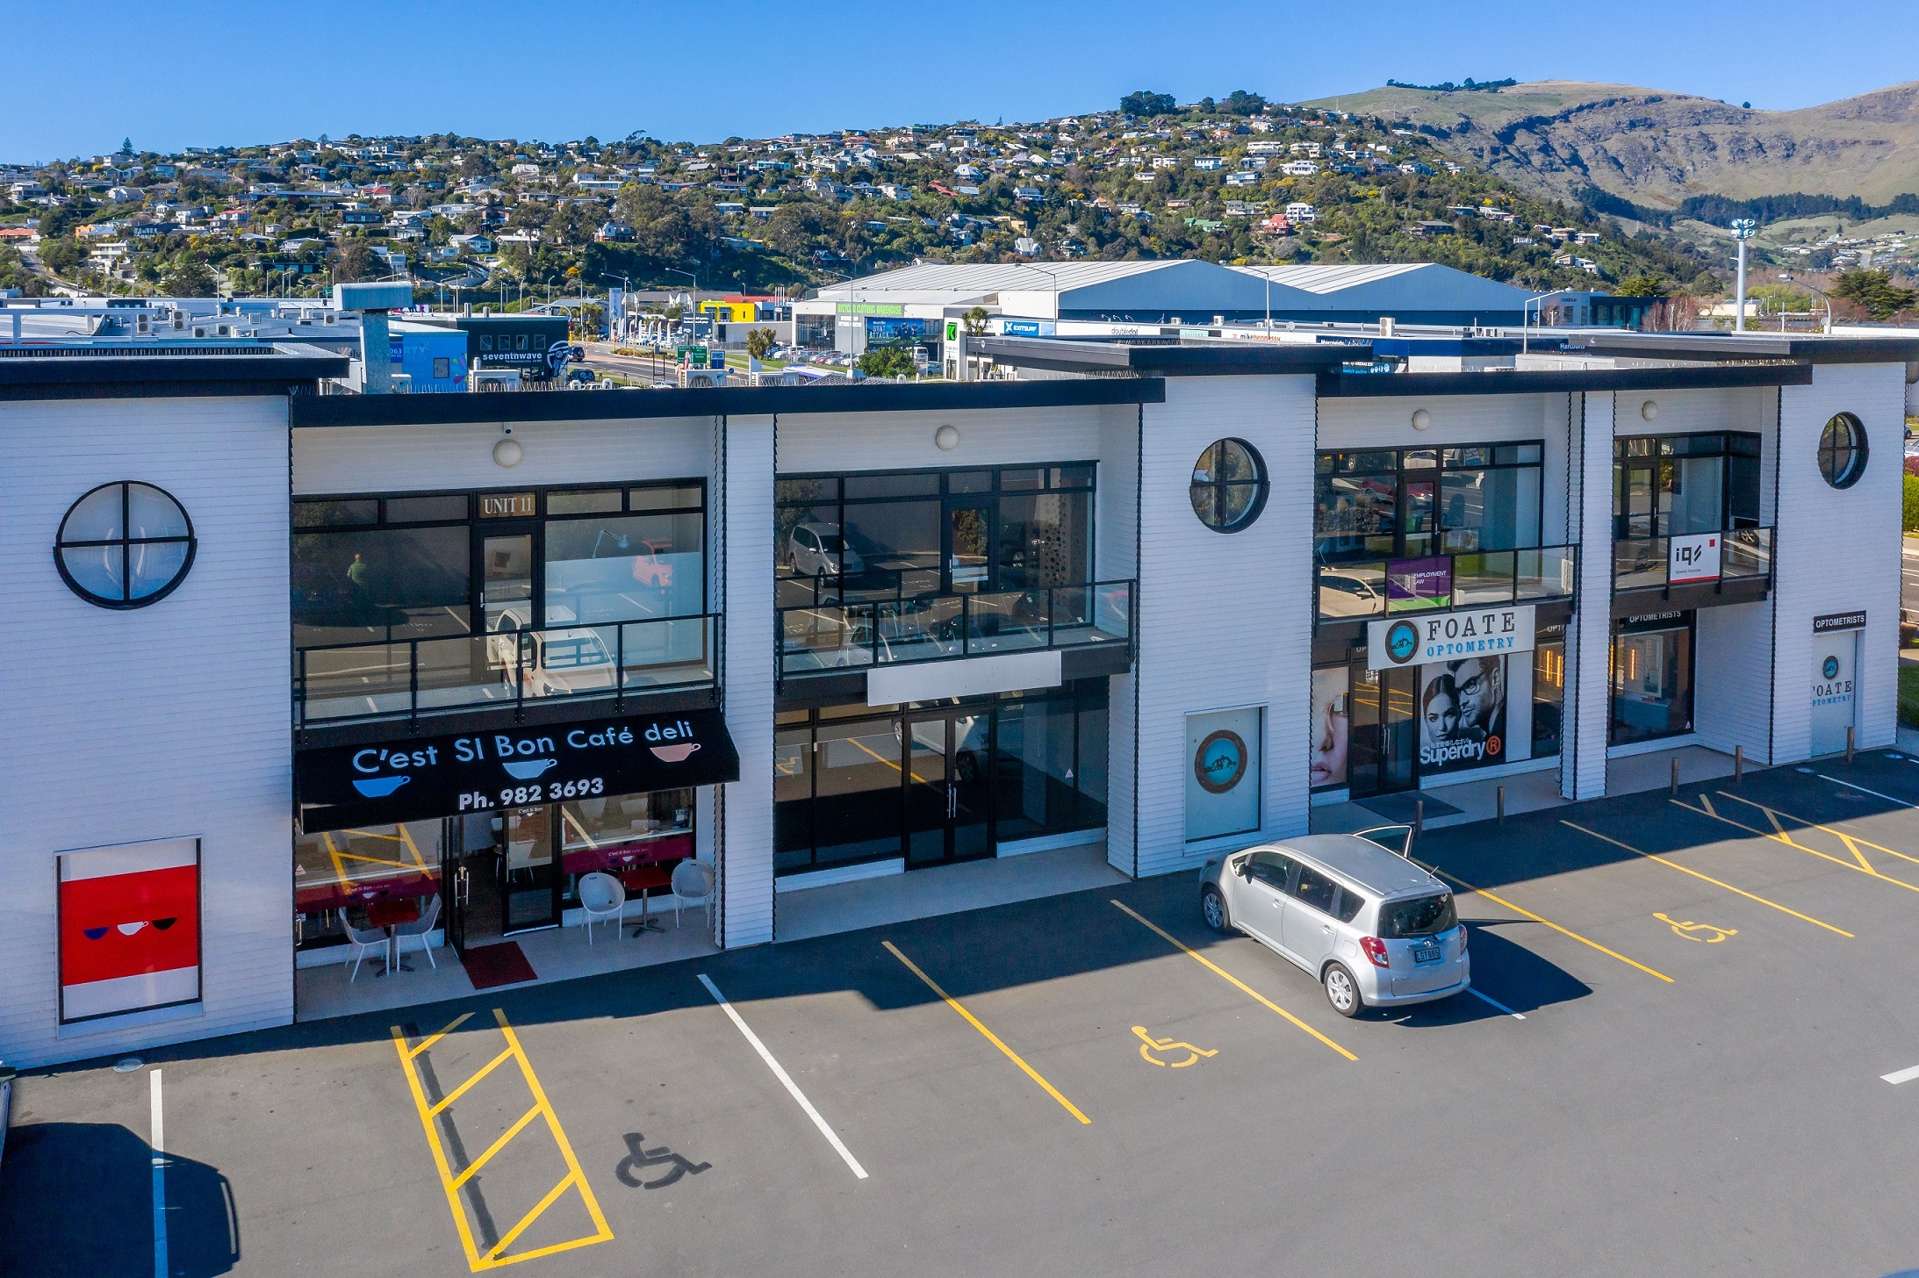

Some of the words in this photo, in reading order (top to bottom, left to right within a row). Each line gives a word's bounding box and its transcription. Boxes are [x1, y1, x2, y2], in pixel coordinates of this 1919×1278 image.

[484, 497, 518, 515] UNIT
[521, 496, 532, 513] 11
[1427, 612, 1515, 641] FOATE
[1815, 615, 1865, 628] OPTOMETRISTS
[1427, 636, 1514, 657] OPTOMETRY
[352, 745, 439, 774] C'est
[495, 734, 556, 758] Bon
[567, 726, 634, 749] Café
[644, 720, 694, 742] deli
[1420, 739, 1486, 767] Superdry
[459, 791, 495, 811] Ph.
[500, 785, 542, 806] 982
[549, 777, 604, 800] 3693
